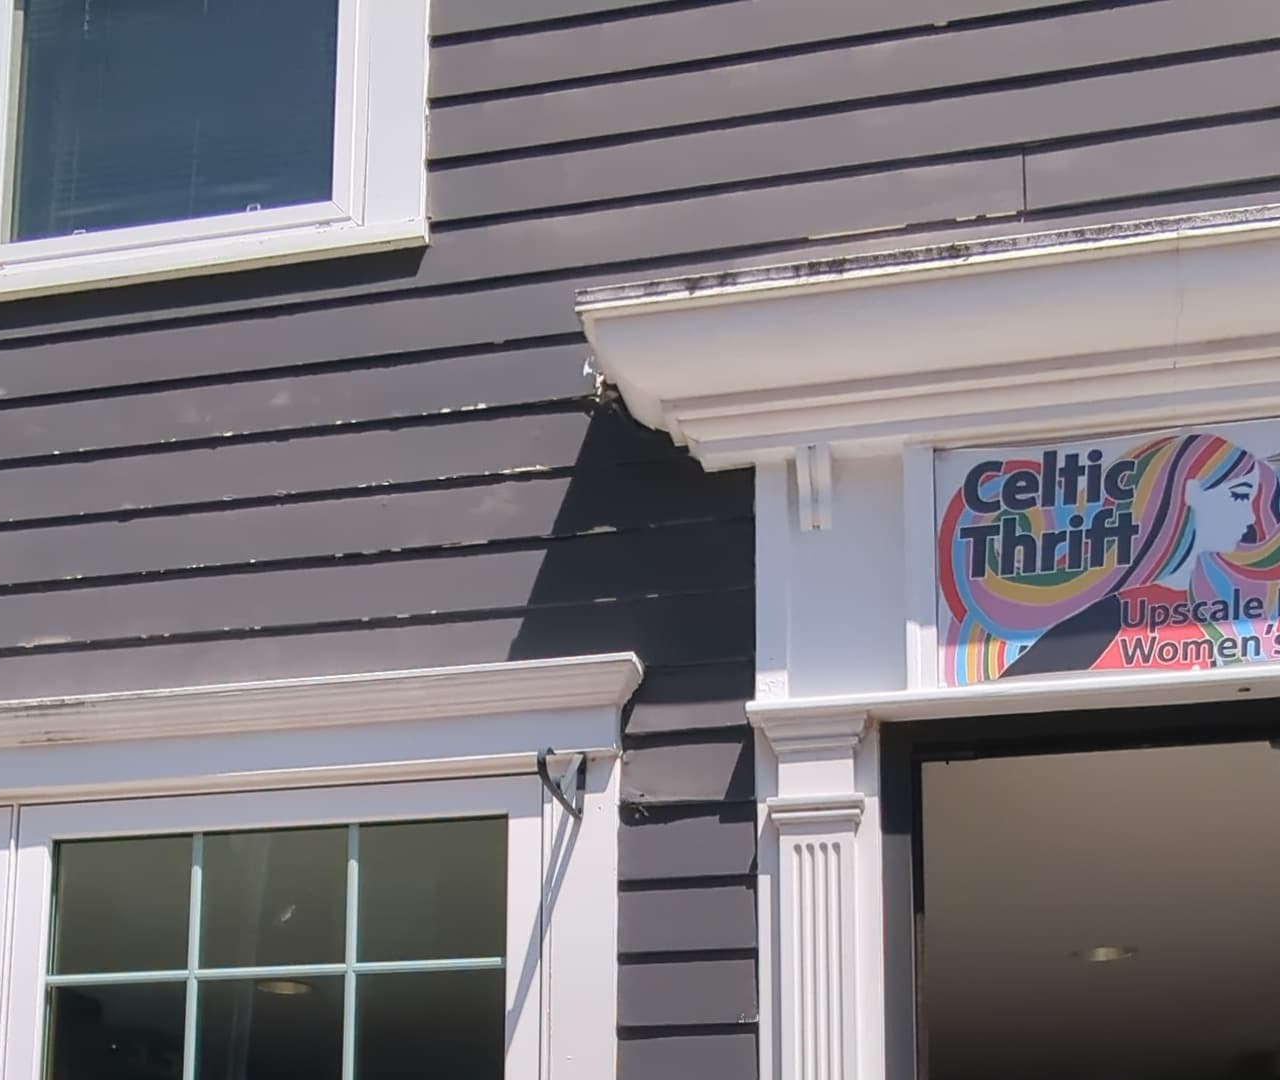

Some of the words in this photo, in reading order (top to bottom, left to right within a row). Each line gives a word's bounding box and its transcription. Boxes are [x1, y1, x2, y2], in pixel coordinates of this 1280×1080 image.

[962, 449, 1135, 515] Celtic
[960, 509, 1140, 581] Thrift
[1121, 585, 1265, 632] Upscale
